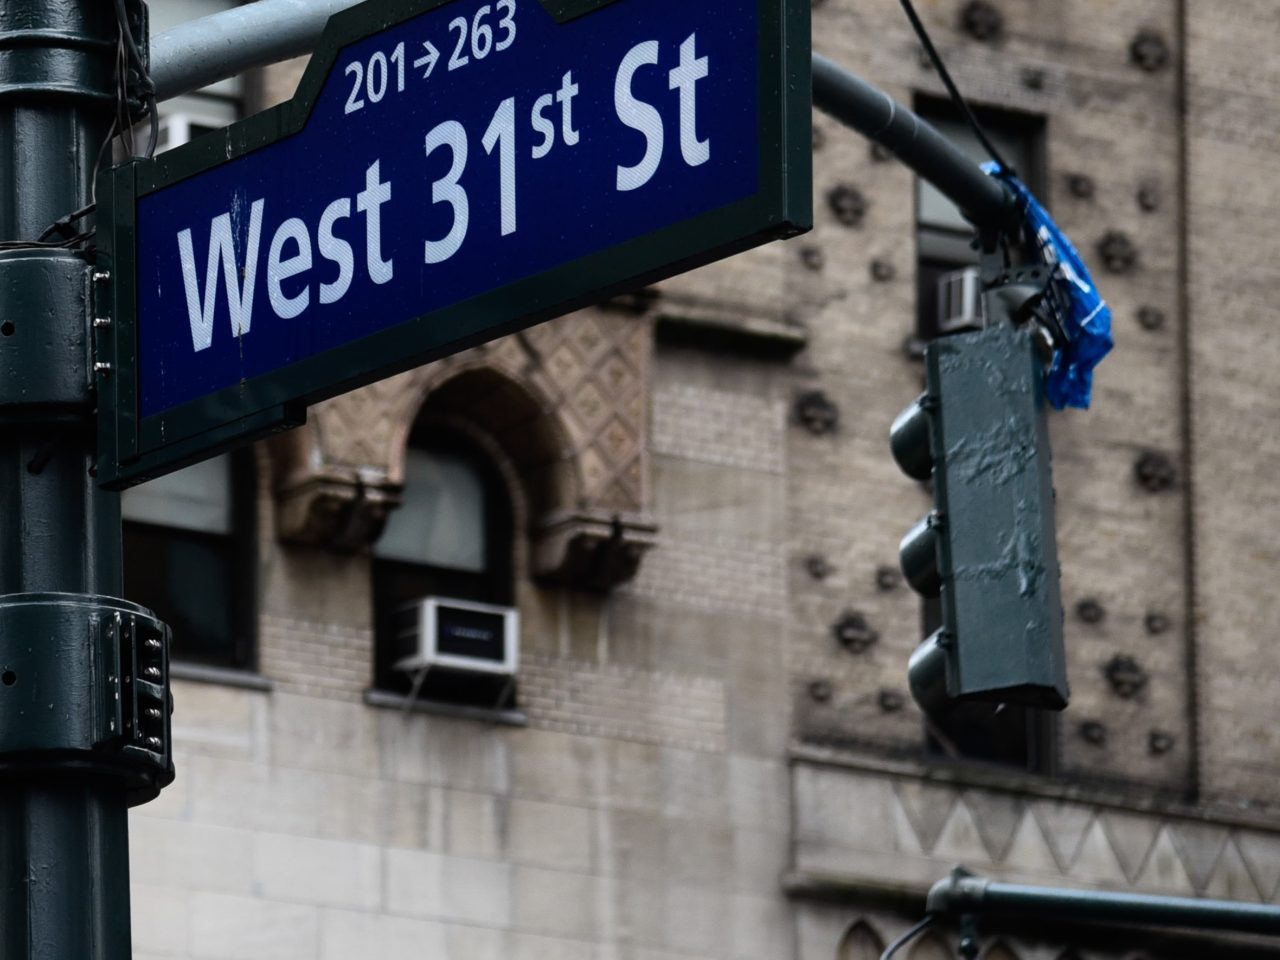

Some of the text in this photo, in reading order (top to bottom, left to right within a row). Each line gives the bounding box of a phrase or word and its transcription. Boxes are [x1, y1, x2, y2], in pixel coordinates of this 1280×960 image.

[344, 41, 406, 115] 201
[176, 32, 710, 353] West 31st St
